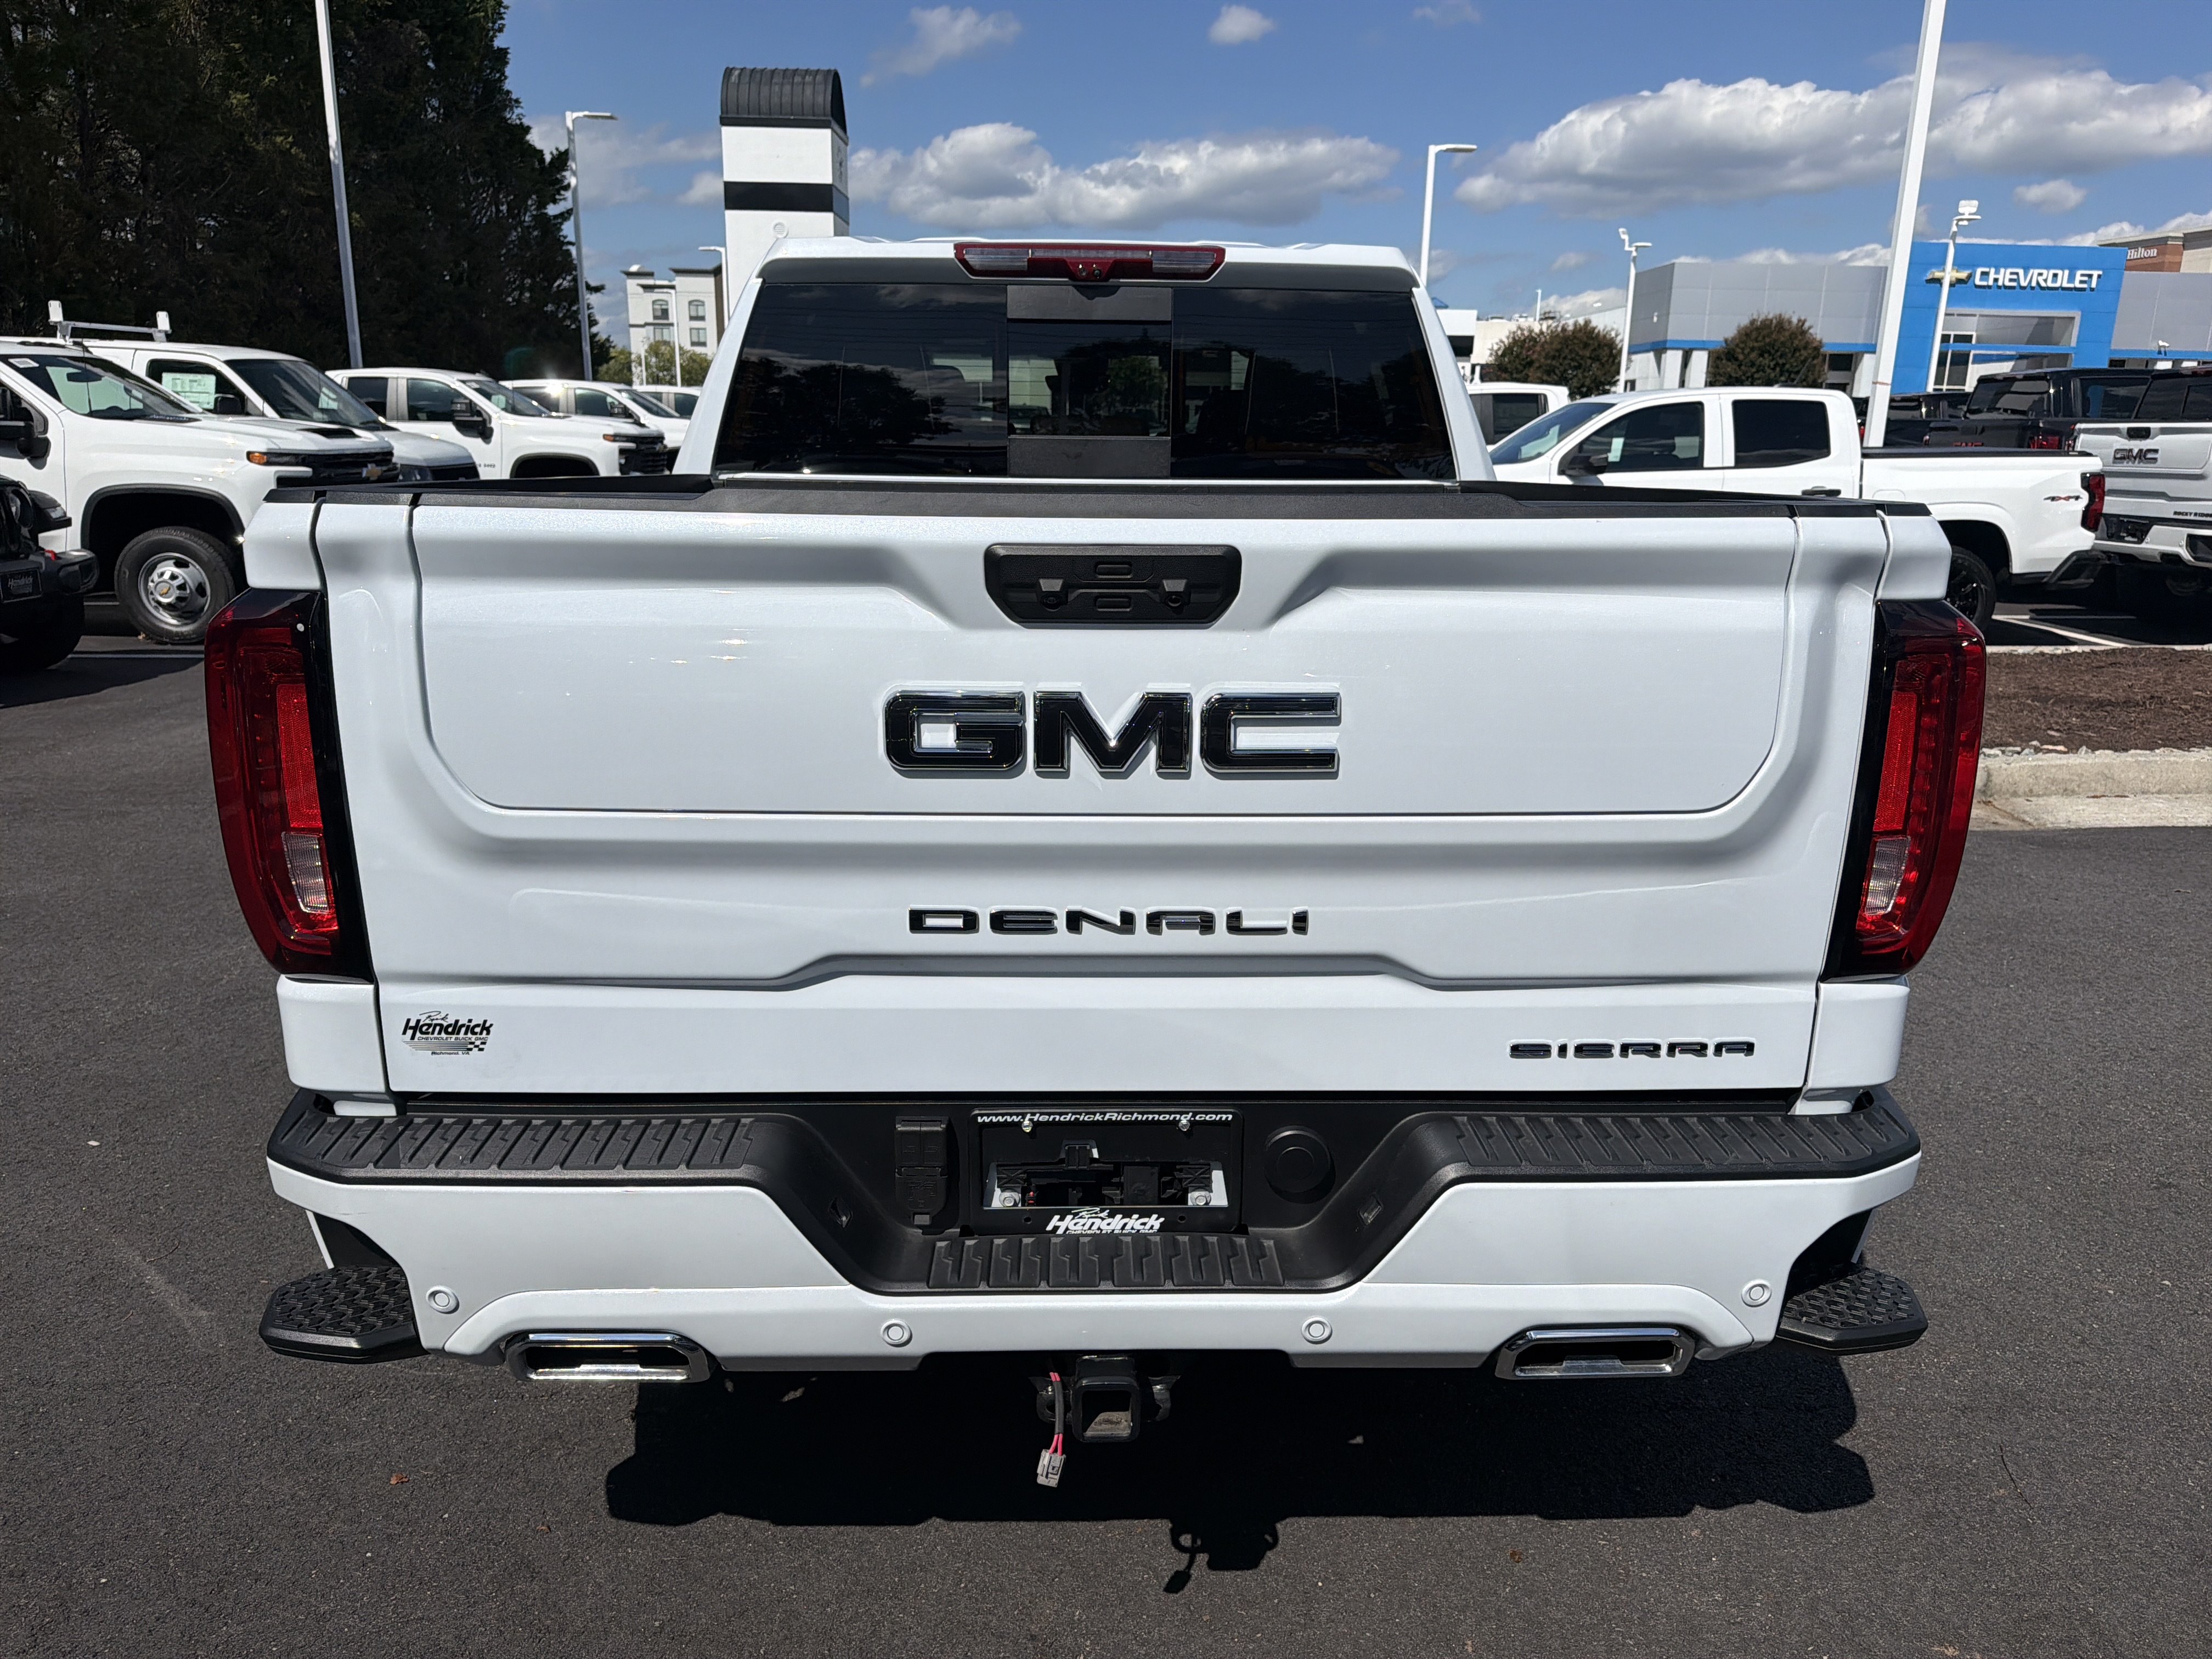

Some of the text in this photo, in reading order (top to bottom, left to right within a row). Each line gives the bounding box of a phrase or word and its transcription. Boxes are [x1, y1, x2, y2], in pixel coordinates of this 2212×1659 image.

[2127, 247, 2157, 260] Hilton
[1974, 267, 2103, 289] CHEVROLET
[2113, 448, 2160, 462] GMC
[884, 690, 1341, 776] GMC
[908, 907, 1309, 935] DENALI
[402, 1018, 494, 1041] Hendrick
[1509, 1040, 1755, 1059] SIERRA
[977, 1113, 1233, 1122] www.HendrickRichmond.com
[1046, 1214, 1165, 1234] Hendrick
